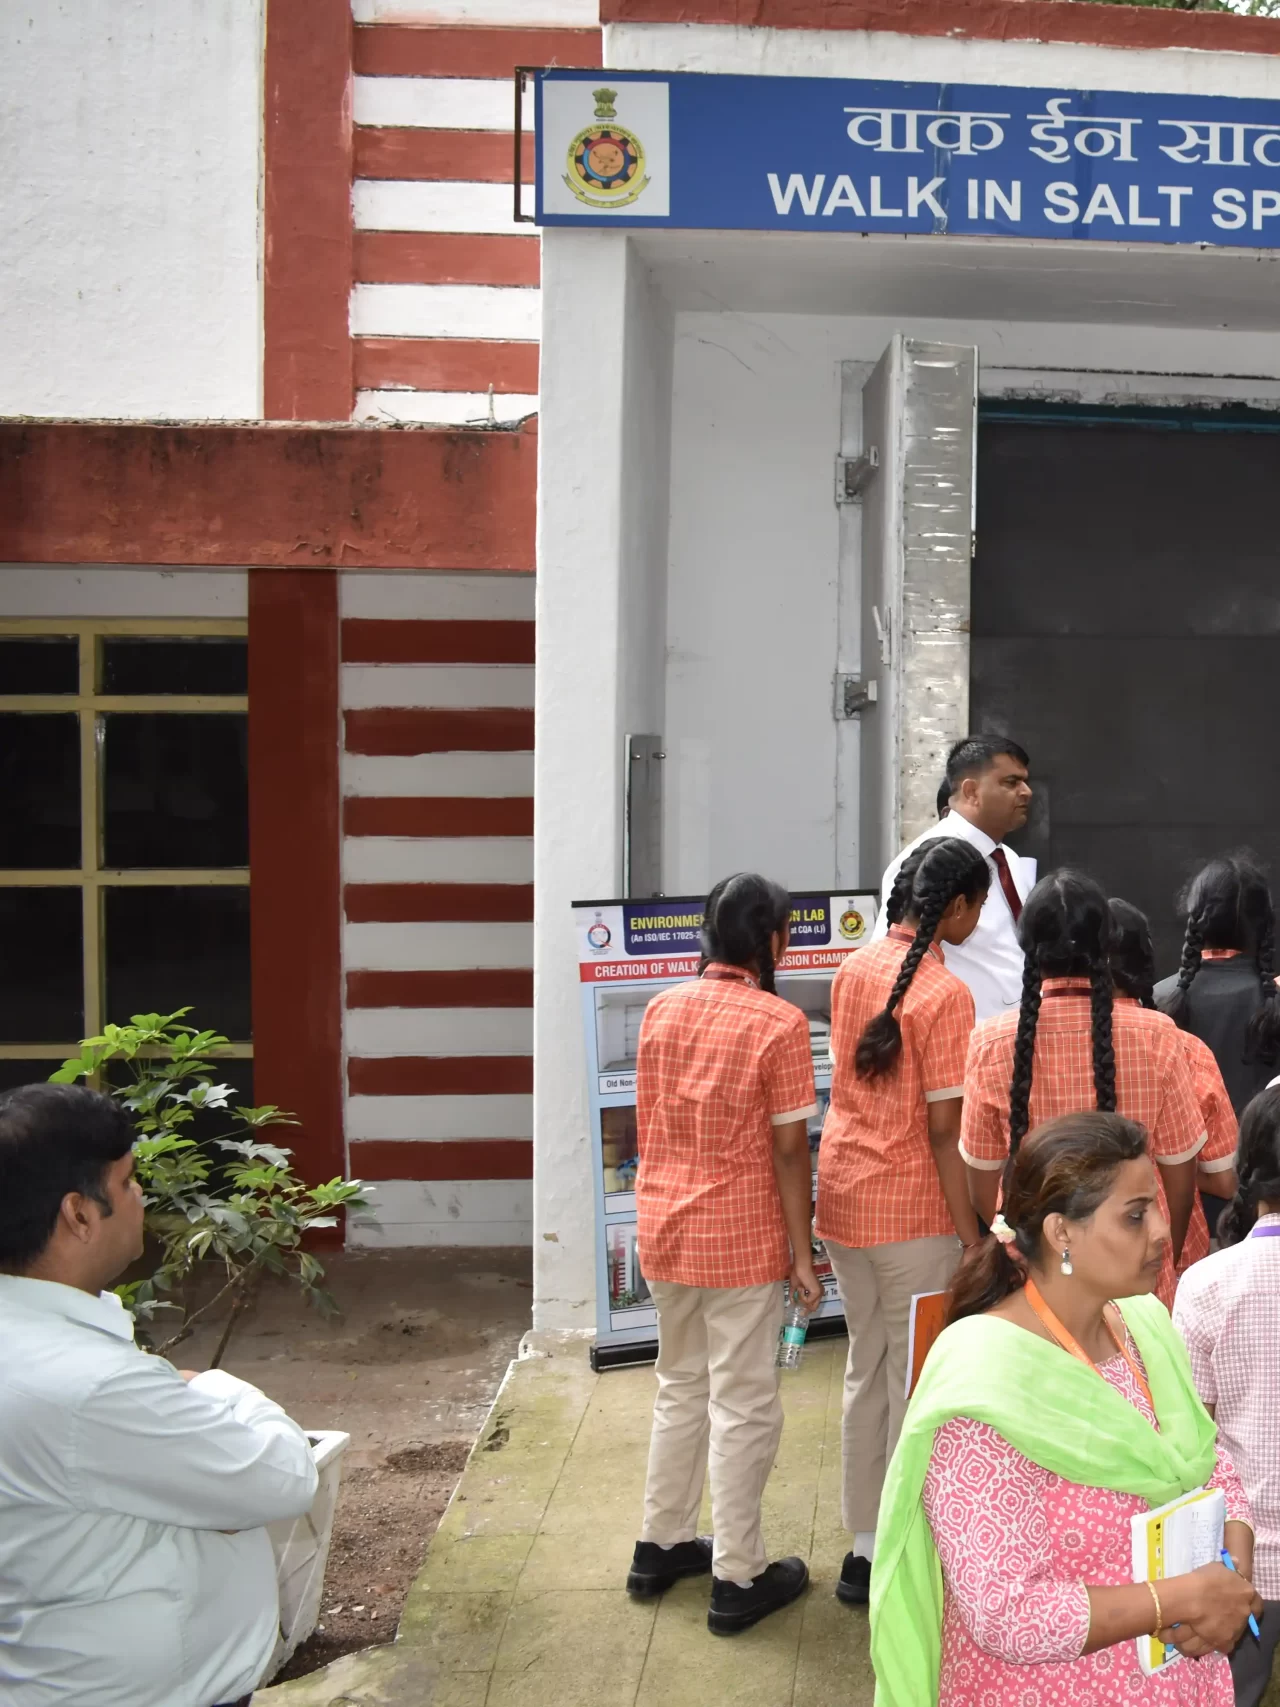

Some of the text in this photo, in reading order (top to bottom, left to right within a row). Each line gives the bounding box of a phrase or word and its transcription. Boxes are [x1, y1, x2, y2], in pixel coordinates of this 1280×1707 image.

[844, 107, 1011, 156] वाक
[1026, 98, 1143, 164] ईन
[767, 173, 949, 219] WALK
[967, 179, 1021, 221] IN
[1043, 180, 1193, 227] SALT
[803, 908, 825, 921] LAB
[631, 934, 643, 944] (An
[644, 932, 671, 942] ISO/IEC
[797, 925, 813, 934] CQA
[813, 924, 826, 934] (L))
[594, 963, 648, 978] CREATION
[650, 962, 665, 975] OF
[812, 952, 849, 965] CHAMB
[606, 1079, 637, 1088] Old Non-
